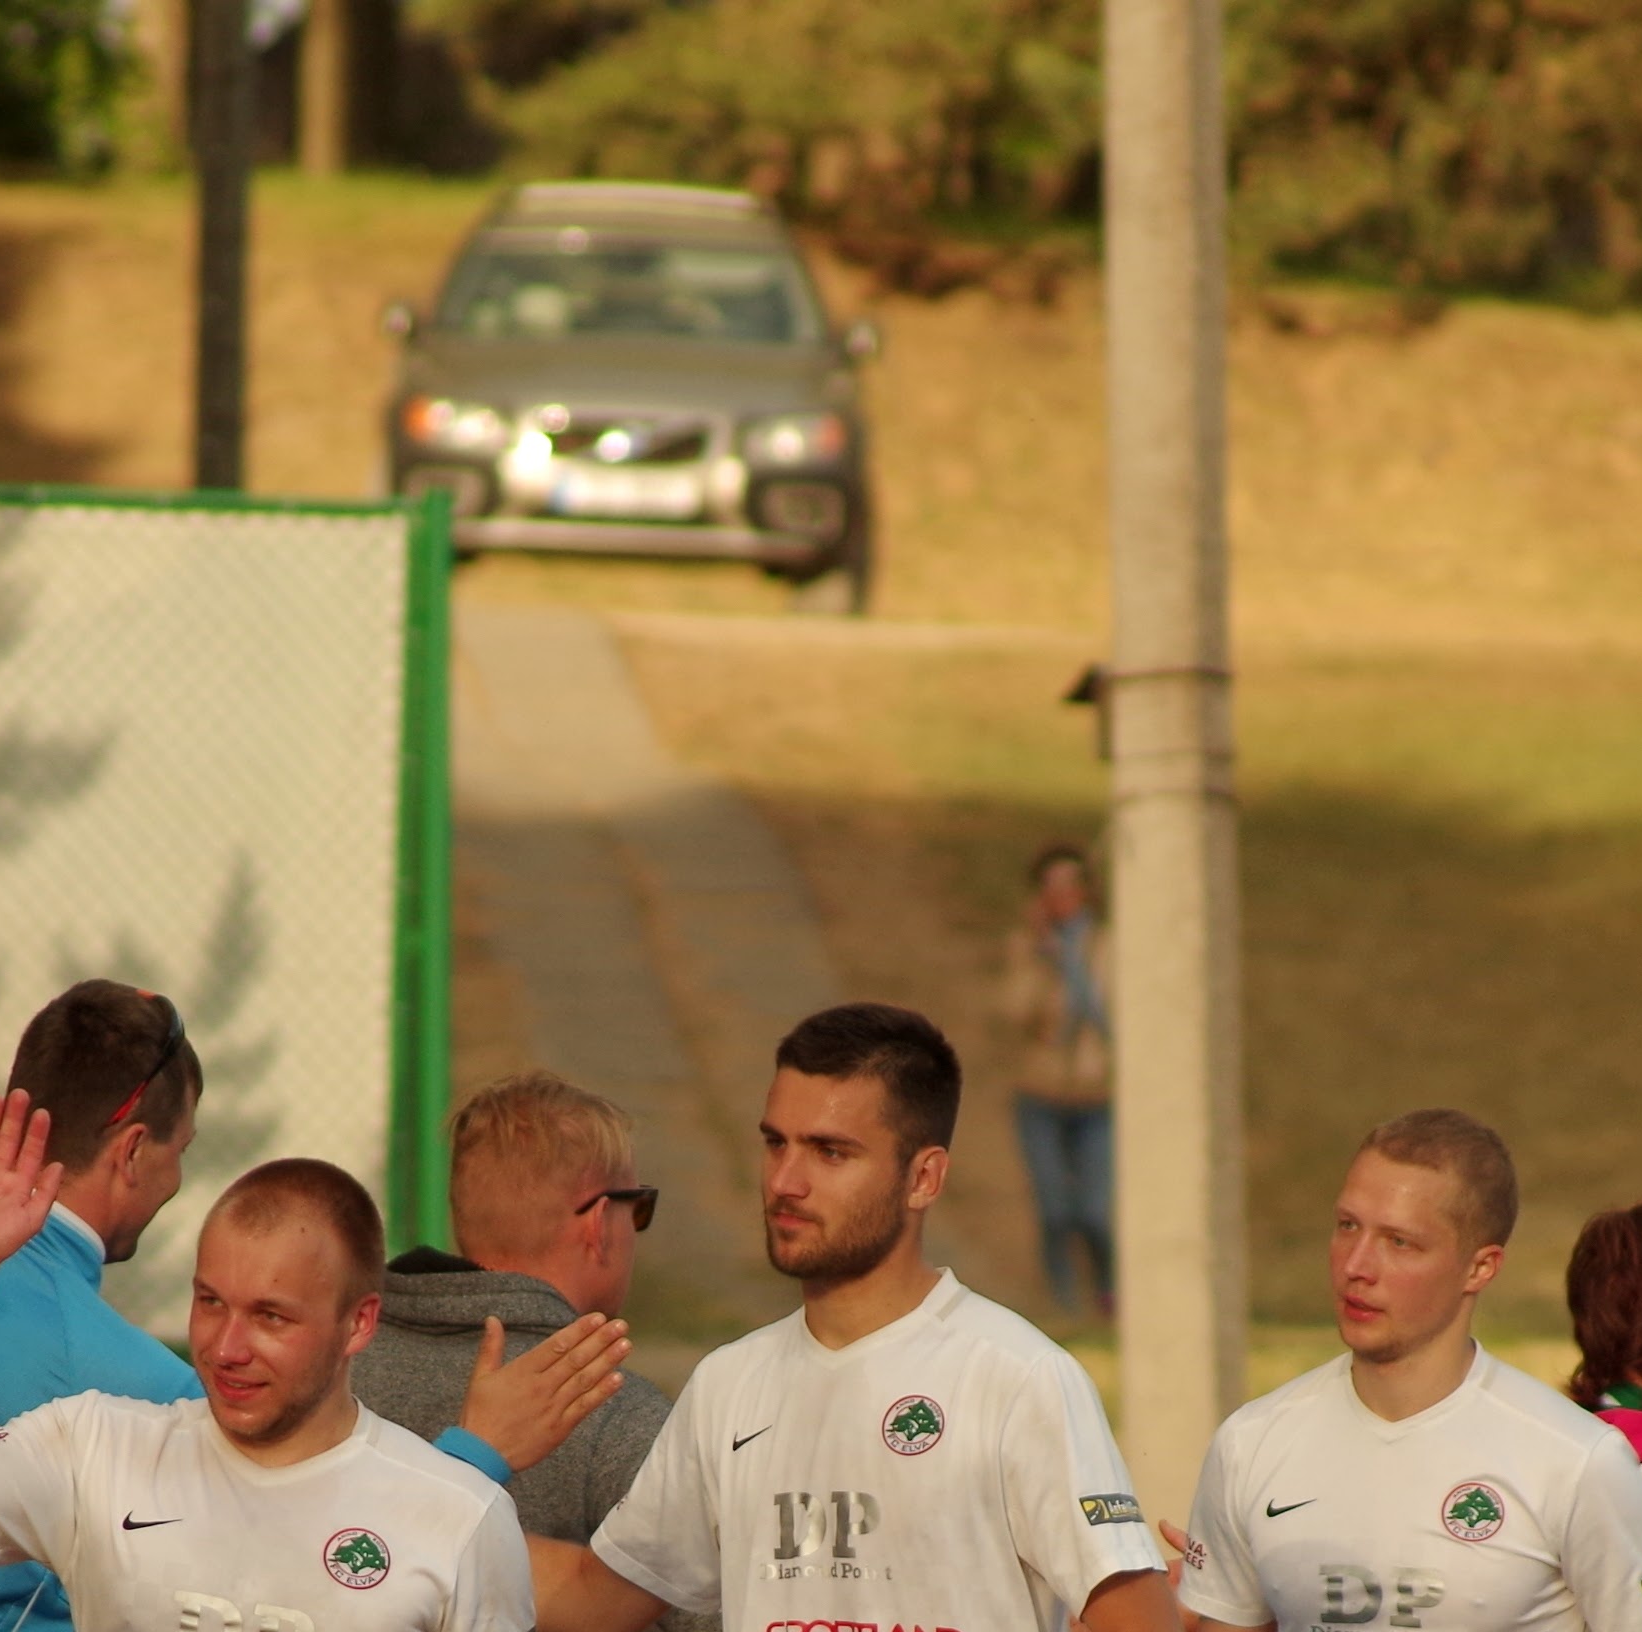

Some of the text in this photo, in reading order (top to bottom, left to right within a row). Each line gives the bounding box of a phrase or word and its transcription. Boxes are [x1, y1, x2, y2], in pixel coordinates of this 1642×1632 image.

[901, 1442, 930, 1452] ELVA
[773, 1491, 882, 1560] DP
[346, 1576, 376, 1585] ELVA
[1319, 1564, 1446, 1628] DP
